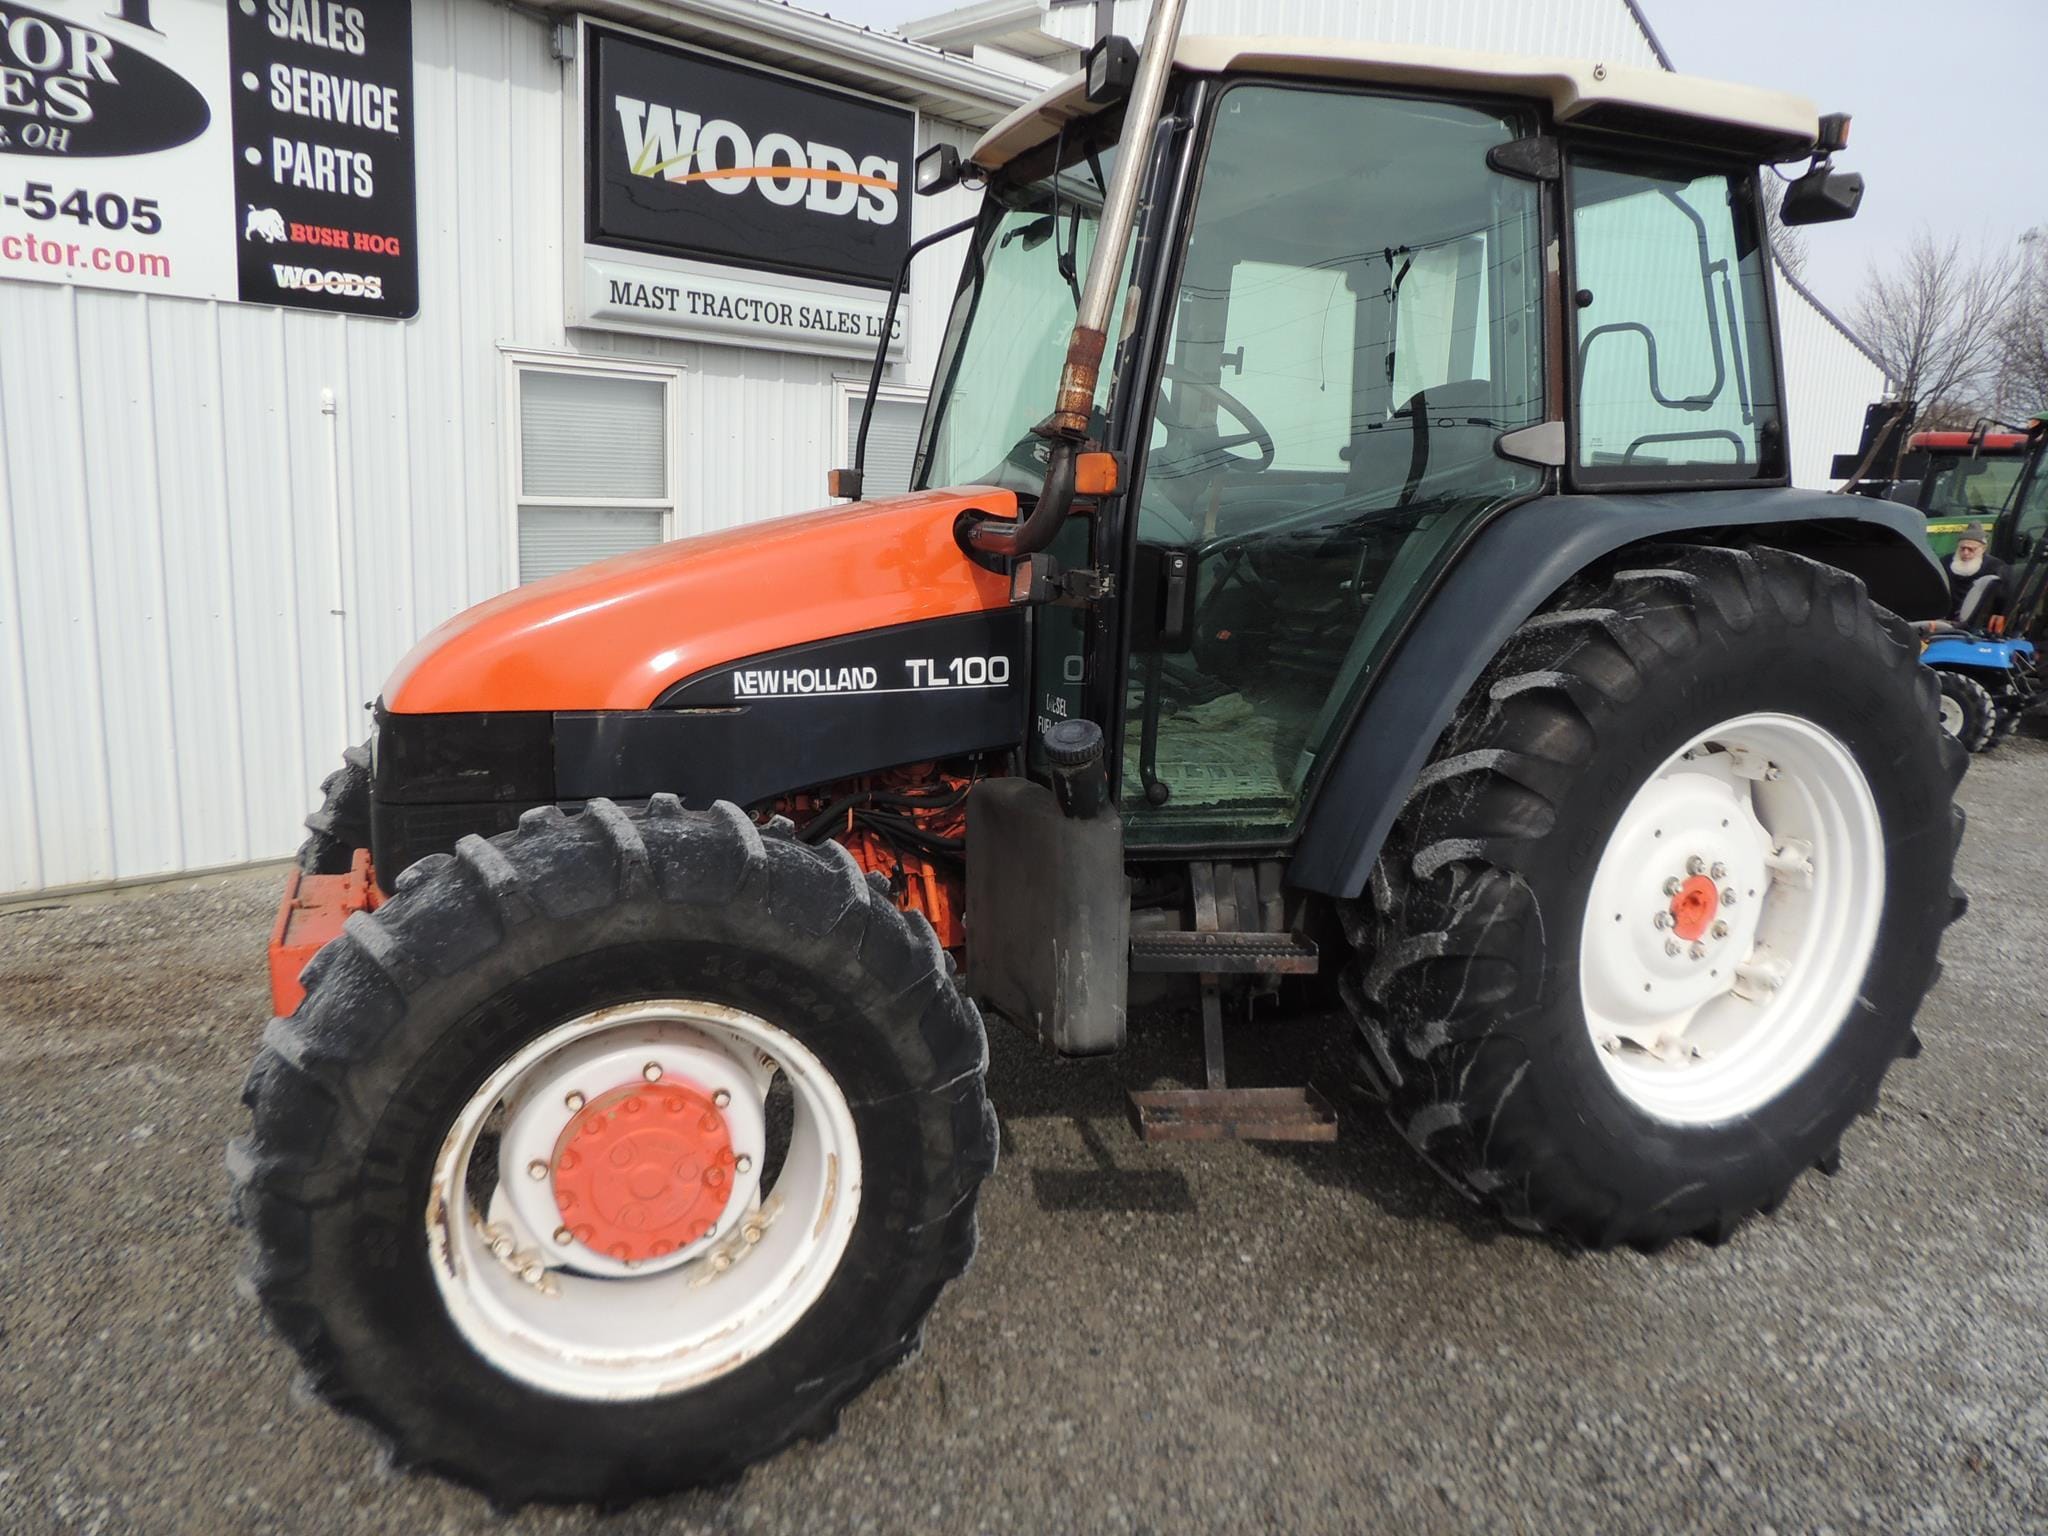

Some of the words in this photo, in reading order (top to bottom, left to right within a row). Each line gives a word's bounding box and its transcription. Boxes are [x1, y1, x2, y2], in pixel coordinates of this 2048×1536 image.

[267, 0, 365, 55] SALES
[270, 63, 399, 134] SERVICE
[22, 123, 71, 152] OH
[616, 95, 898, 225] WOODS
[272, 137, 374, 198] PARTS
[4, 180, 162, 235] -5405
[2, 233, 170, 277] ctor.com
[290, 222, 348, 248] BUSH
[354, 232, 400, 257] HOG
[273, 264, 382, 299] WOODS
[610, 279, 679, 311] MAST
[687, 291, 793, 327] TRACTOR
[799, 306, 861, 335] SALES
[905, 655, 1009, 687] TL100
